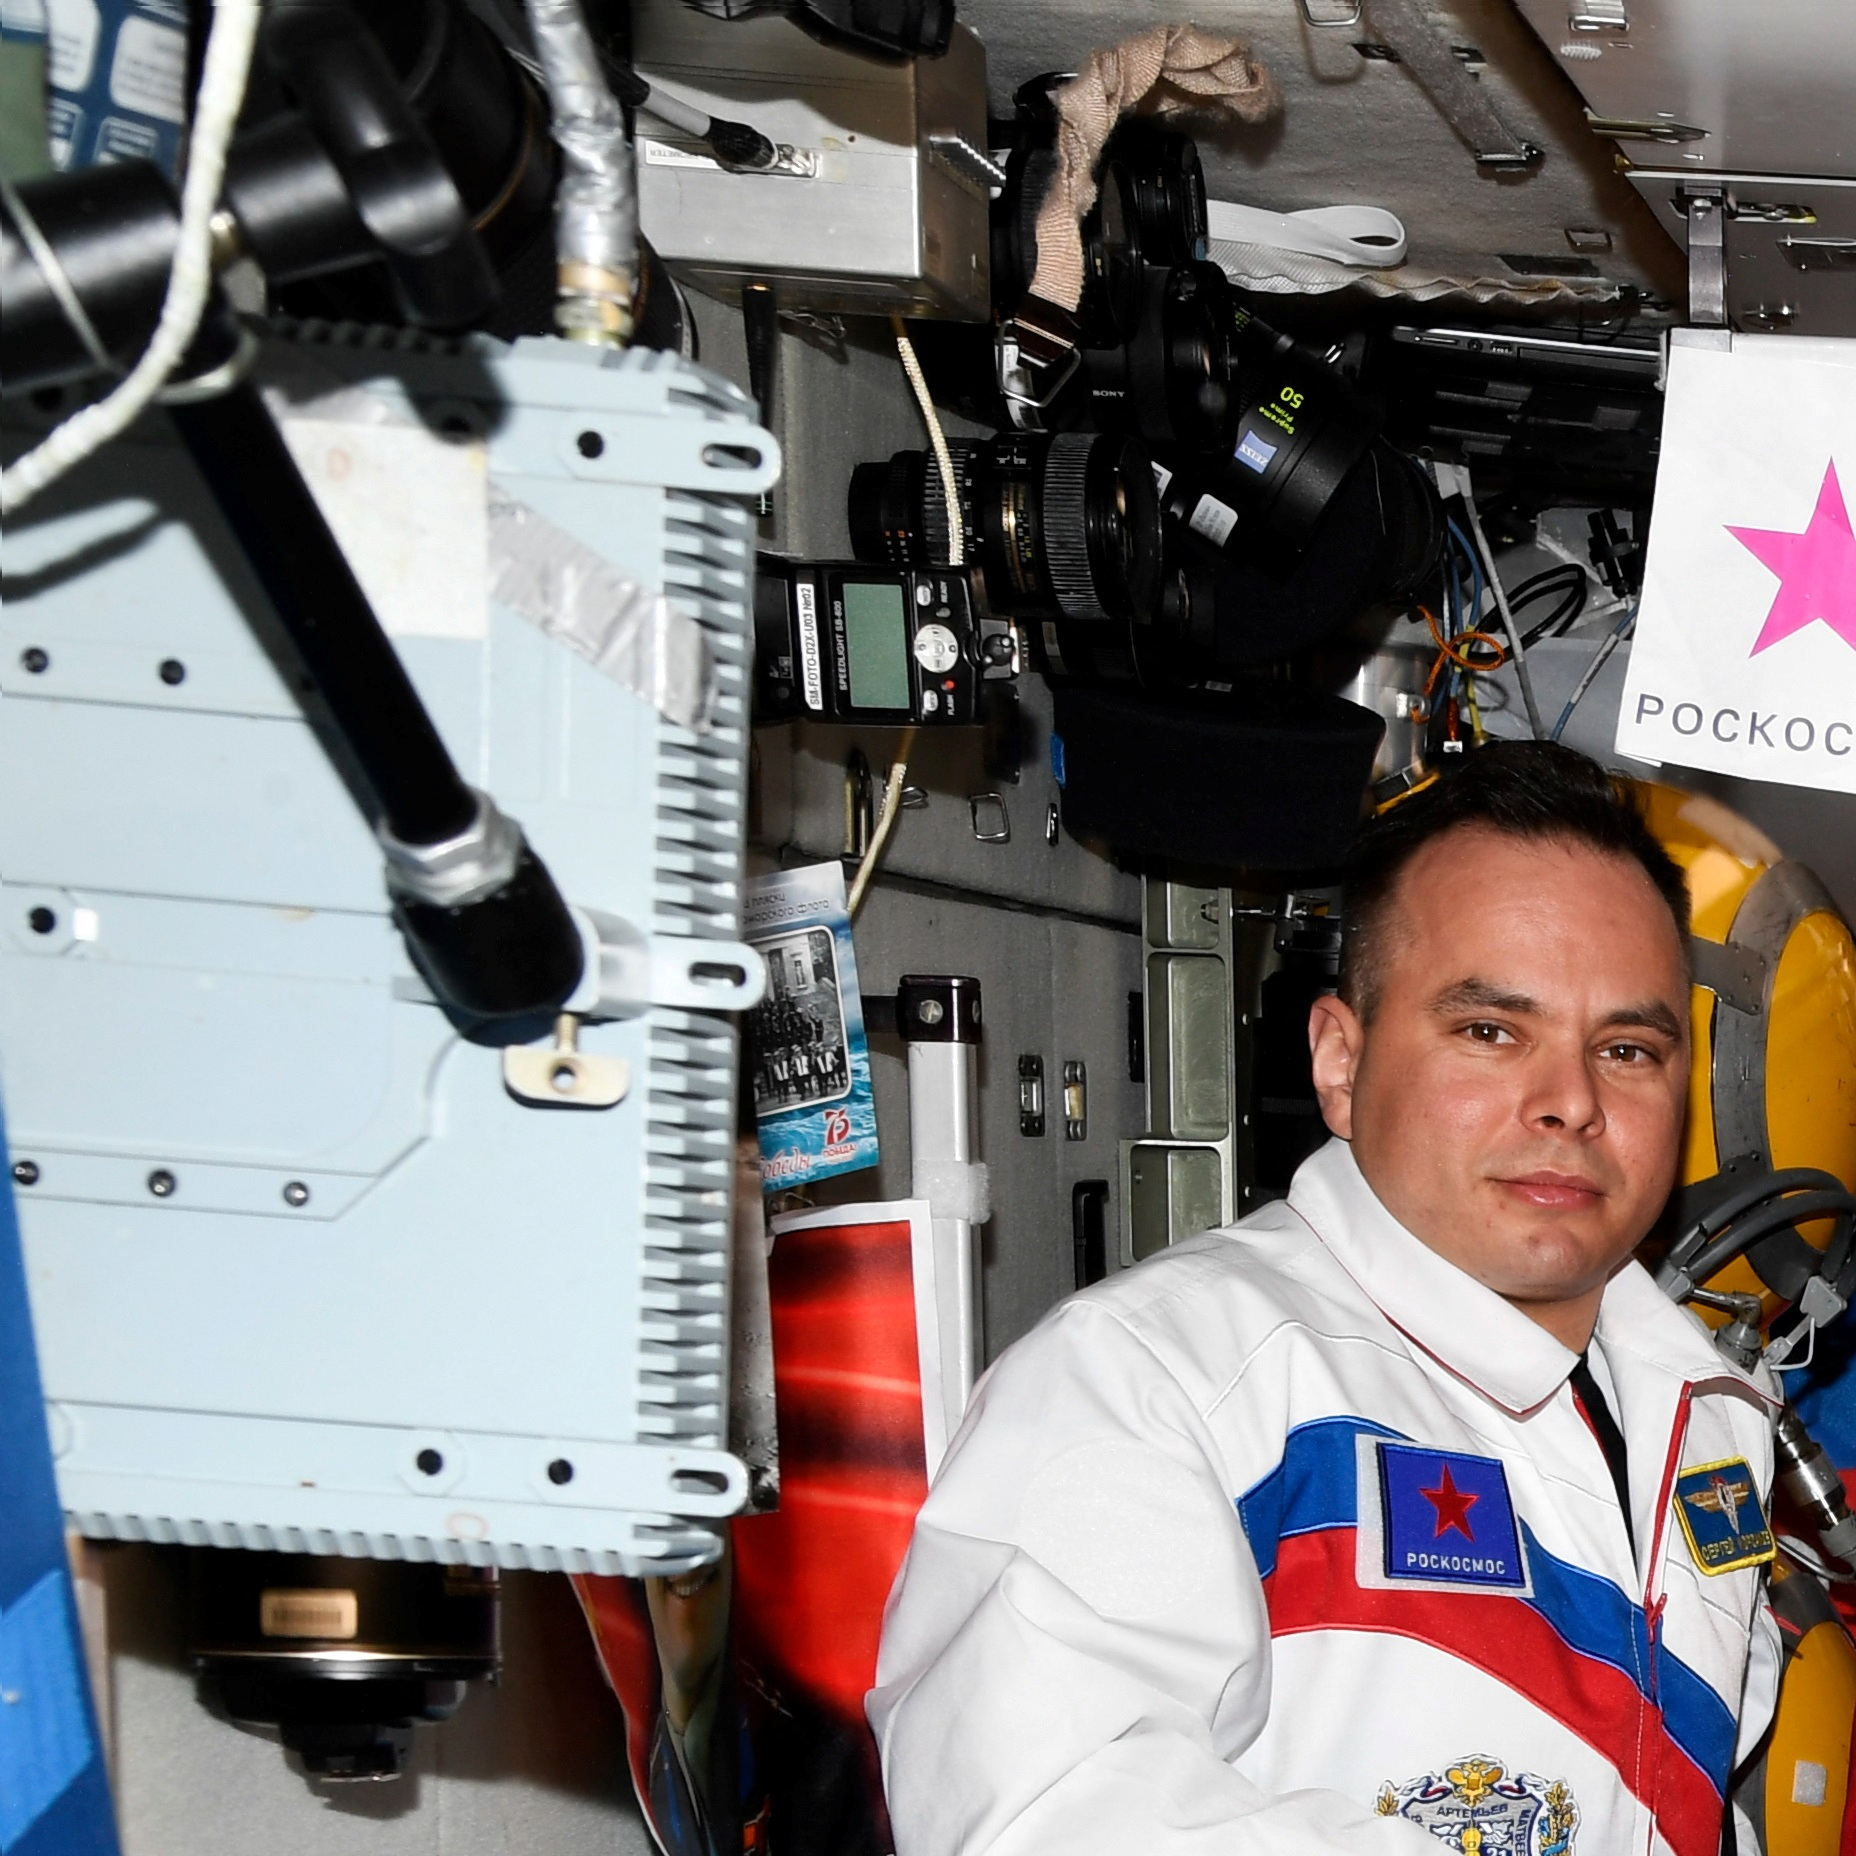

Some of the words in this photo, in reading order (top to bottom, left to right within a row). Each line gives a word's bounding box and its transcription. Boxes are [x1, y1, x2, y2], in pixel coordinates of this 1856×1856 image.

[1092, 389, 1125, 399] SONY
[1280, 386, 1305, 409] 50
[1257, 405, 1296, 436] Supreme
[1269, 402, 1295, 423] Prime
[1240, 443, 1272, 464] ZEISS
[836, 634, 848, 691] SPEEDLIGHT
[756, 891, 786, 907] пляски
[797, 899, 830, 914] флота
[824, 1108, 850, 1146] 75
[1407, 1552, 1506, 1575] РОСКОСМОС
[1436, 1803, 1509, 1818] АРТЕМЬЕВ
